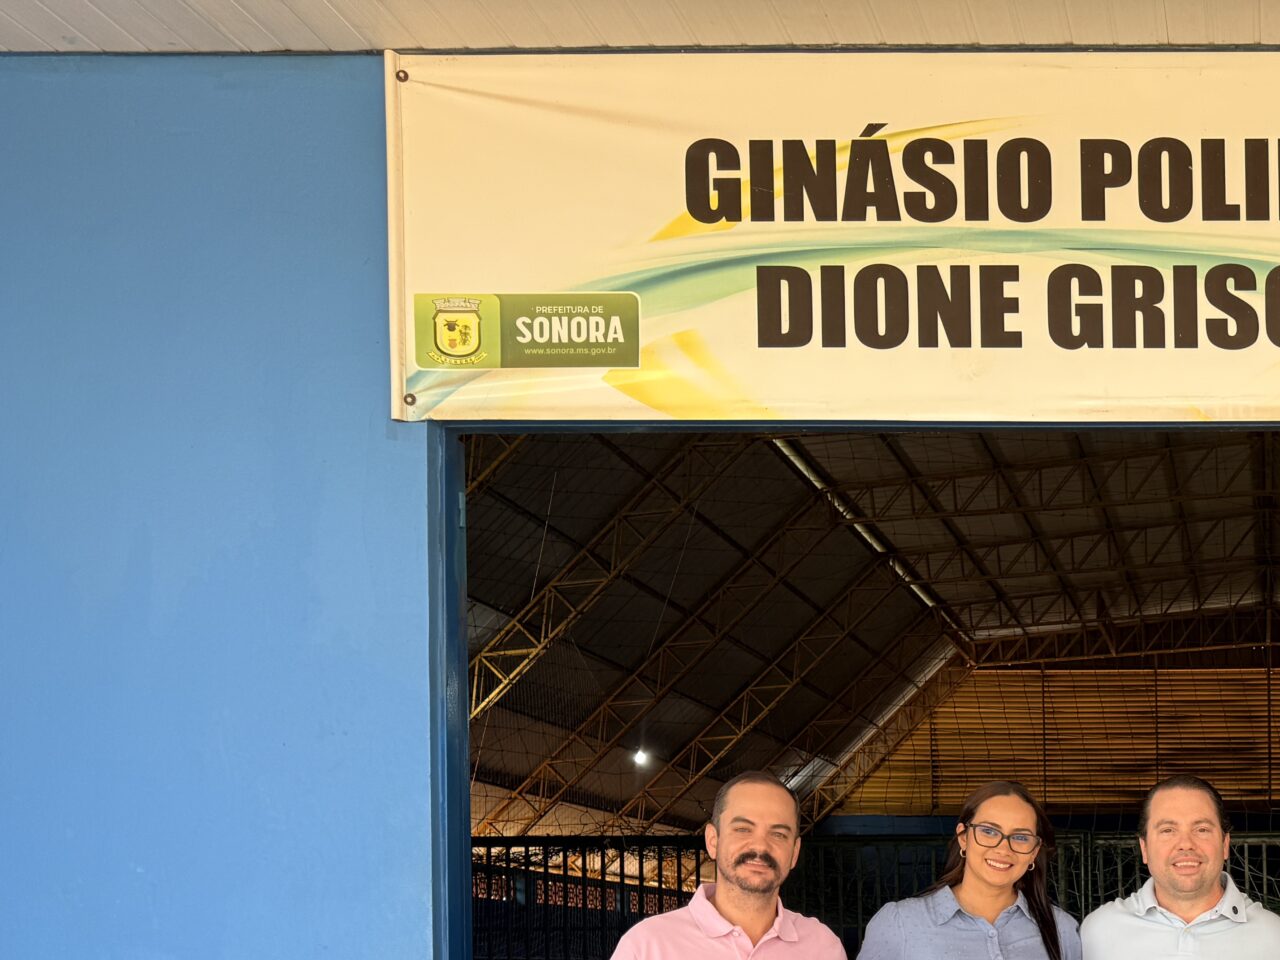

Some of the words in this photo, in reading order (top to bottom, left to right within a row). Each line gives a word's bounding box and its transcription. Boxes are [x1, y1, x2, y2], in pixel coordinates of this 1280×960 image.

[685, 123, 1052, 224] GINÁSIO
[535, 305, 590, 314] PREFEITURA
[591, 305, 604, 313] DE
[756, 265, 1023, 349] DIONE
[515, 315, 625, 344] SONORA
[524, 346, 616, 356] www.sonora.ms.gov.br
